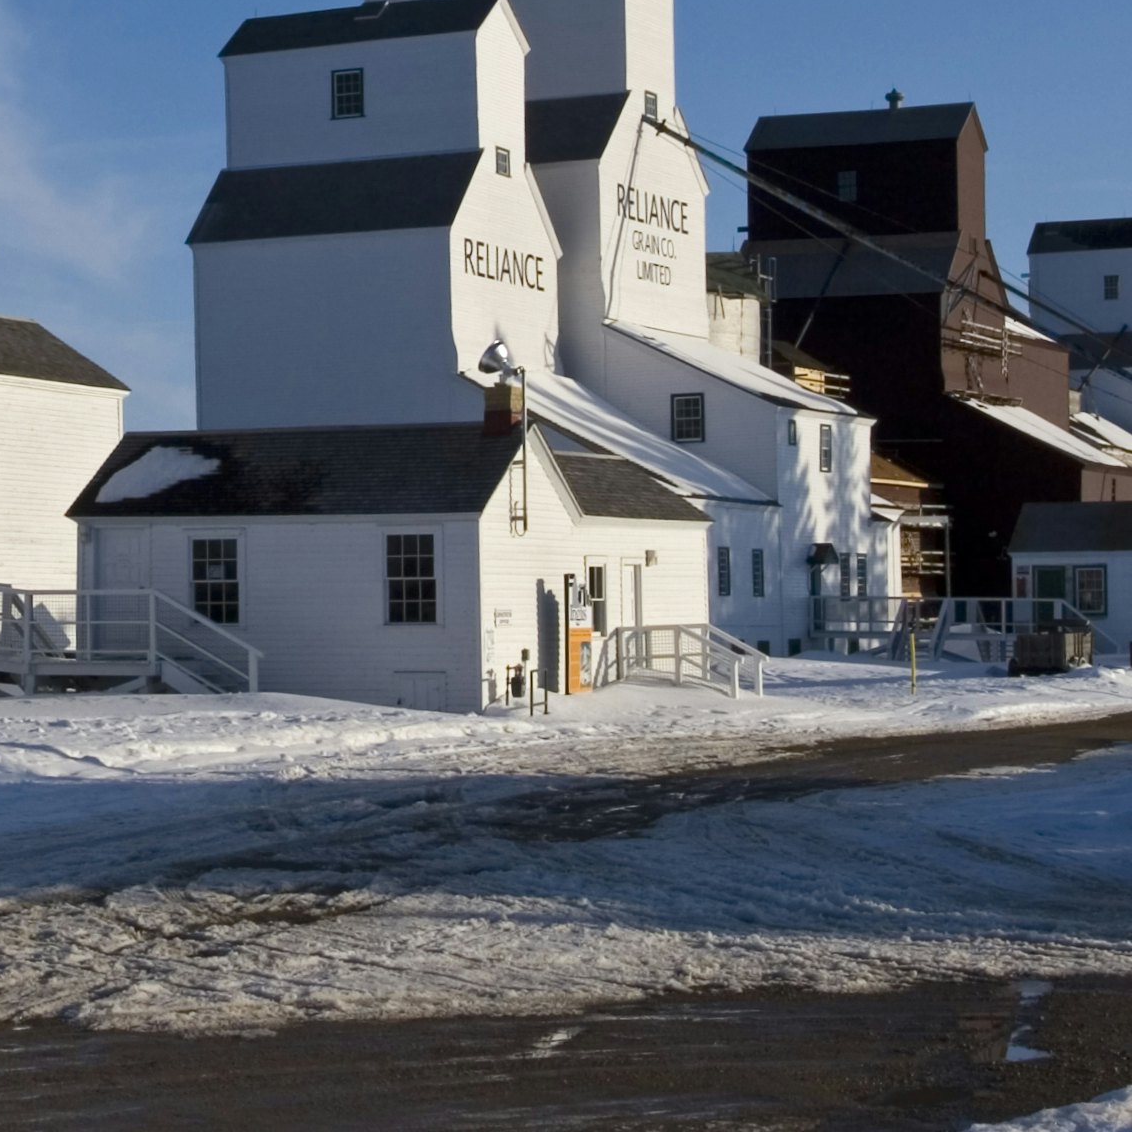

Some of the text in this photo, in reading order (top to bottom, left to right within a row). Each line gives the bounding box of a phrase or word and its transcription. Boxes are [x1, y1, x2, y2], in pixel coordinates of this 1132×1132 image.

[617, 183, 689, 235] RELIANCE
[464, 238, 545, 292] RELIANCE
[636, 259, 672, 286] LIMITED
